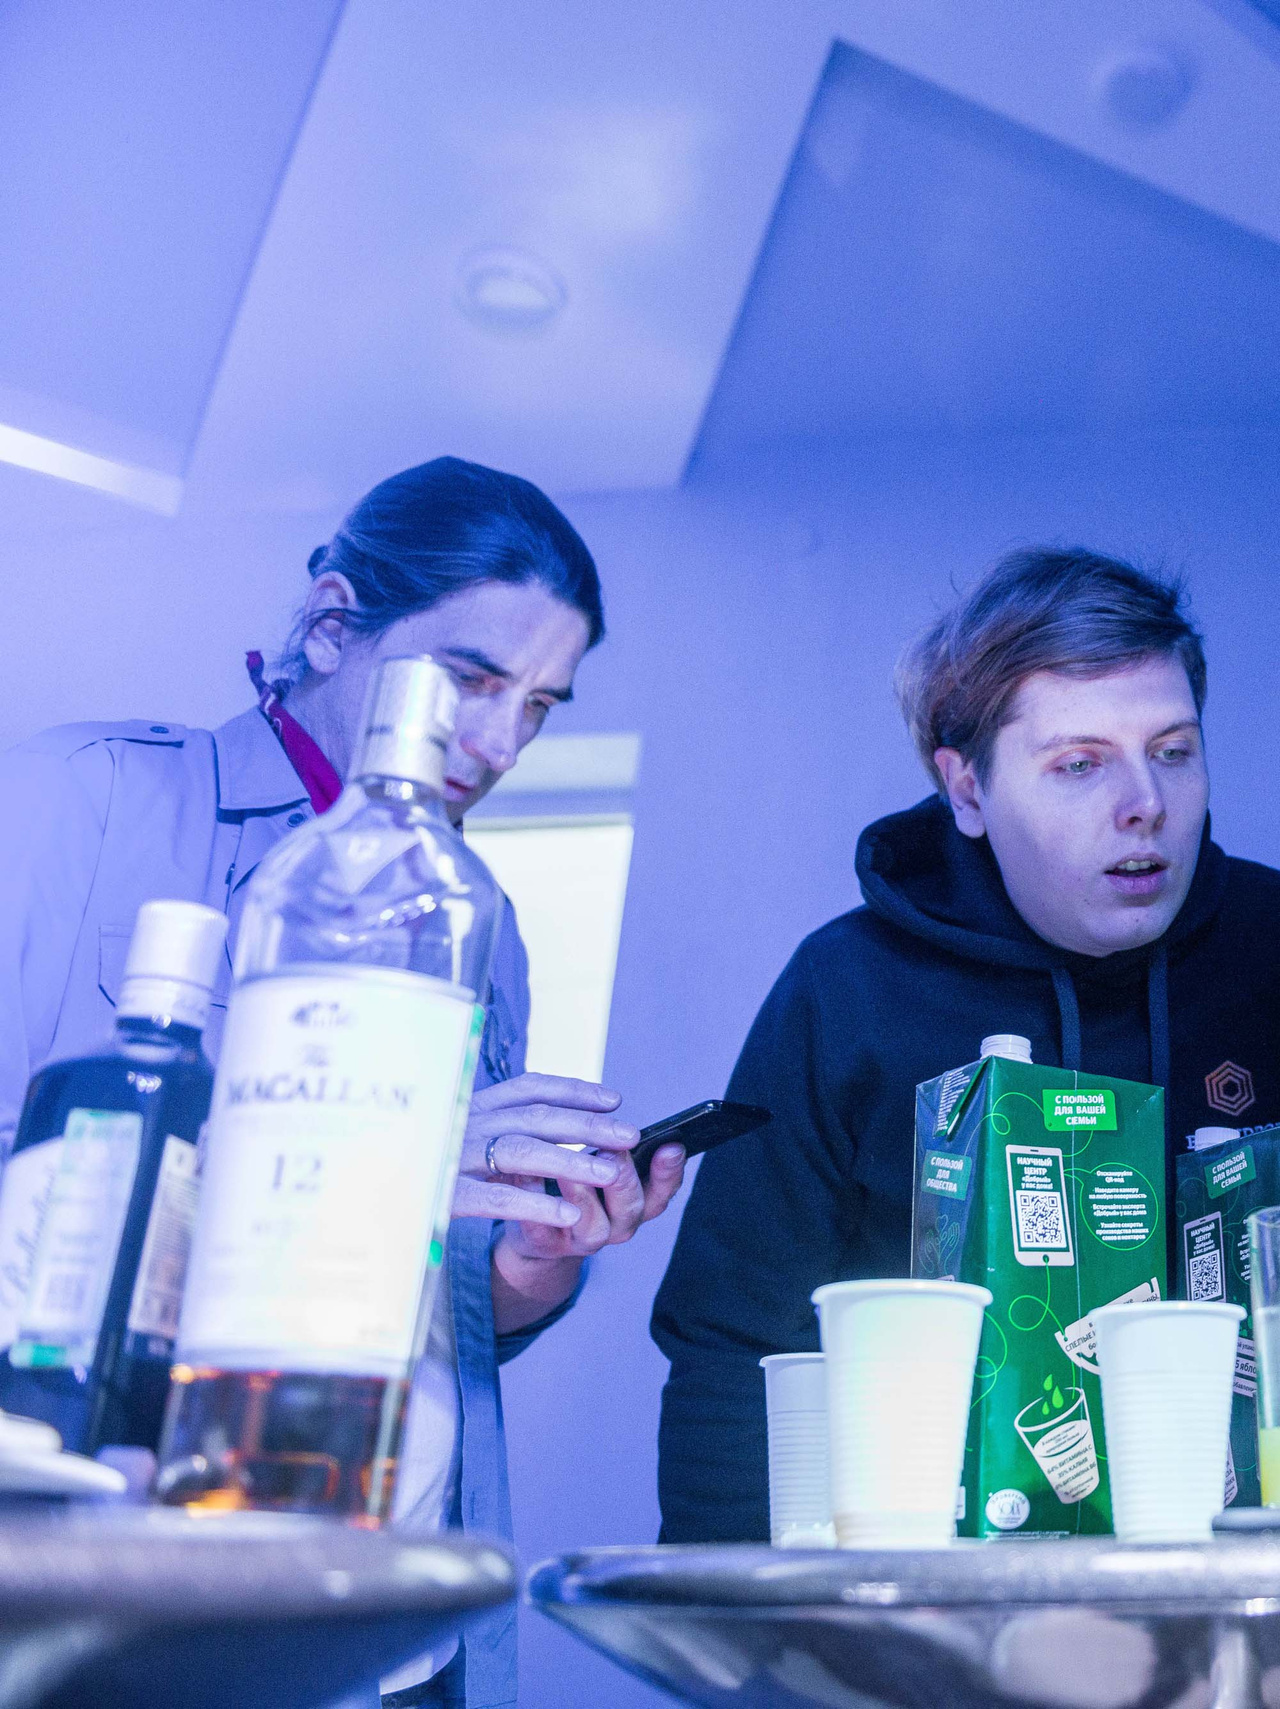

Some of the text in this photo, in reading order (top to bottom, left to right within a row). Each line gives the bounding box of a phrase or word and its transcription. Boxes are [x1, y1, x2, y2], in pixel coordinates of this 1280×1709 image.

[1055, 1093, 1104, 1104] С ПОЛЬЗОЙ
[1054, 1104, 1106, 1116] ДЛЯ ВАШЕЙ
[1066, 1116, 1097, 1125] СЕМЬИ
[936, 1157, 964, 1170] ПОЛЬЗОЙ
[1016, 1156, 1052, 1166] НАУЧНЫЙ
[1217, 1151, 1245, 1172] ПОЛЬЗОЙ
[272, 1153, 324, 1191] 12
[936, 1169, 950, 1179] ДЛЯ
[1024, 1166, 1048, 1176] ЦЕНТР
[1213, 1160, 1248, 1185] ДЛЯ ВАШЕЙ
[926, 1178, 958, 1192] ОБЩЕСТВА
[1221, 1173, 1242, 1188] СЕМЬИ
[1190, 1222, 1215, 1237] НАУЧНЫЙ
[1195, 1232, 1212, 1243] ЦЕНТР
[1065, 1331, 1092, 1352] СПЕЛЫЕ
[1058, 1448, 1088, 1468] ВИТАМИНА
